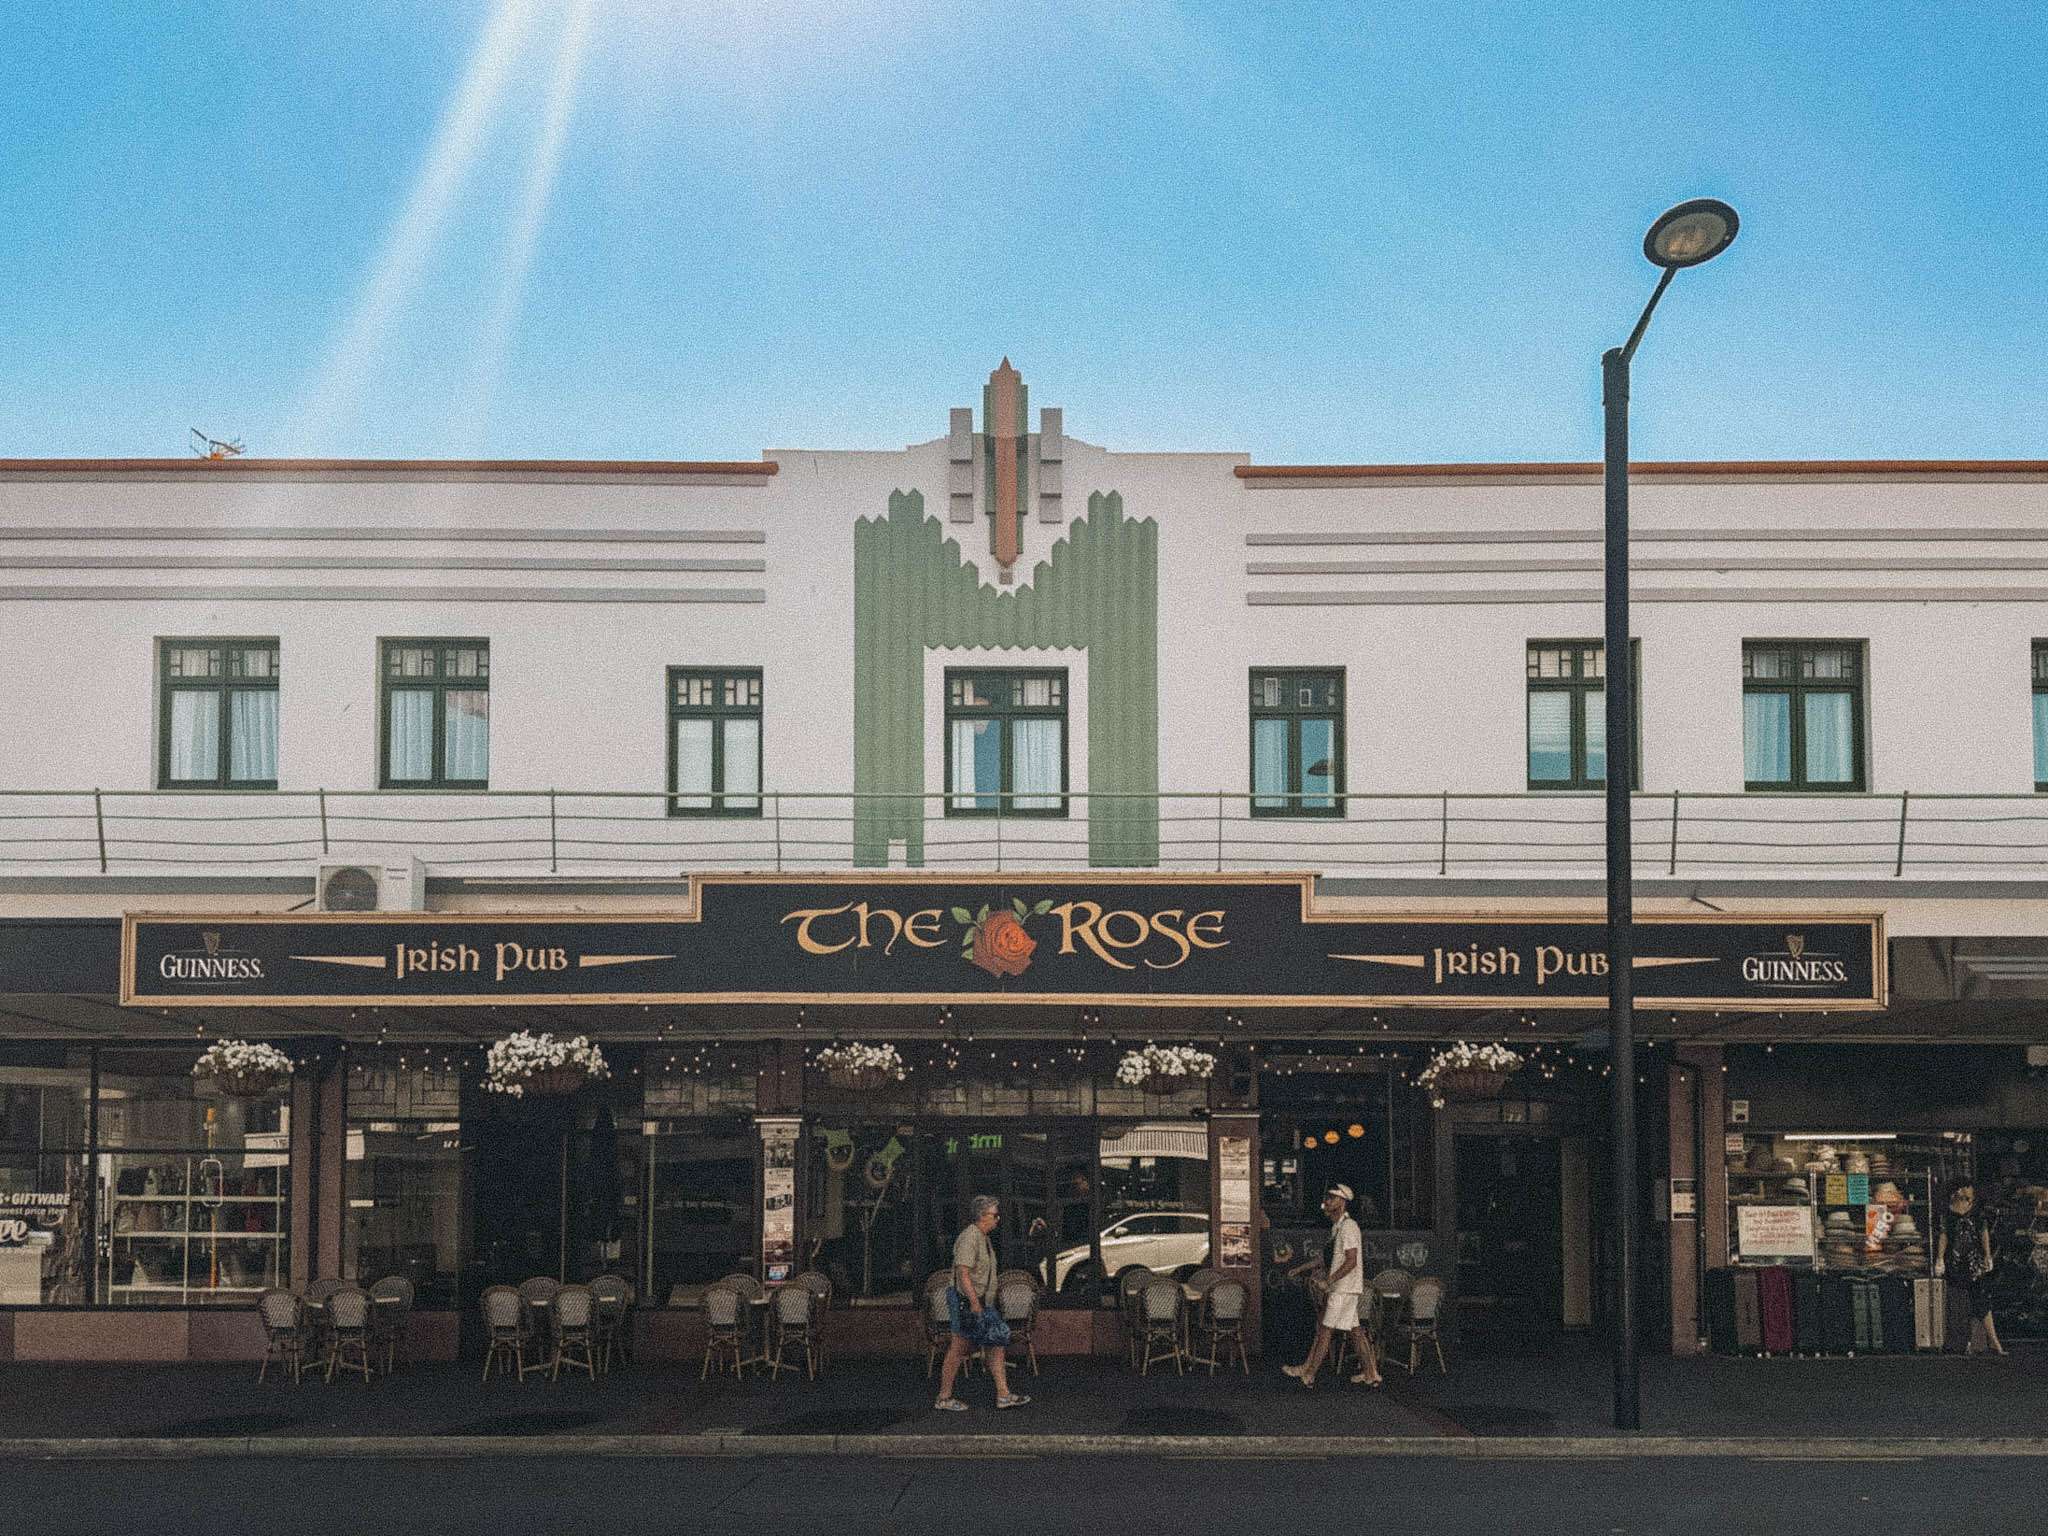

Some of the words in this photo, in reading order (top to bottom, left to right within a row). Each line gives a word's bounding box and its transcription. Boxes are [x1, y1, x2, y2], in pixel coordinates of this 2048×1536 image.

[779, 900, 948, 956] The
[396, 940, 480, 979] Irish
[495, 942, 568, 981] Pub
[1434, 943, 1520, 984] Irish
[11, 1192, 71, 1205] GIFTWARE
[24, 1207, 47, 1216] price
